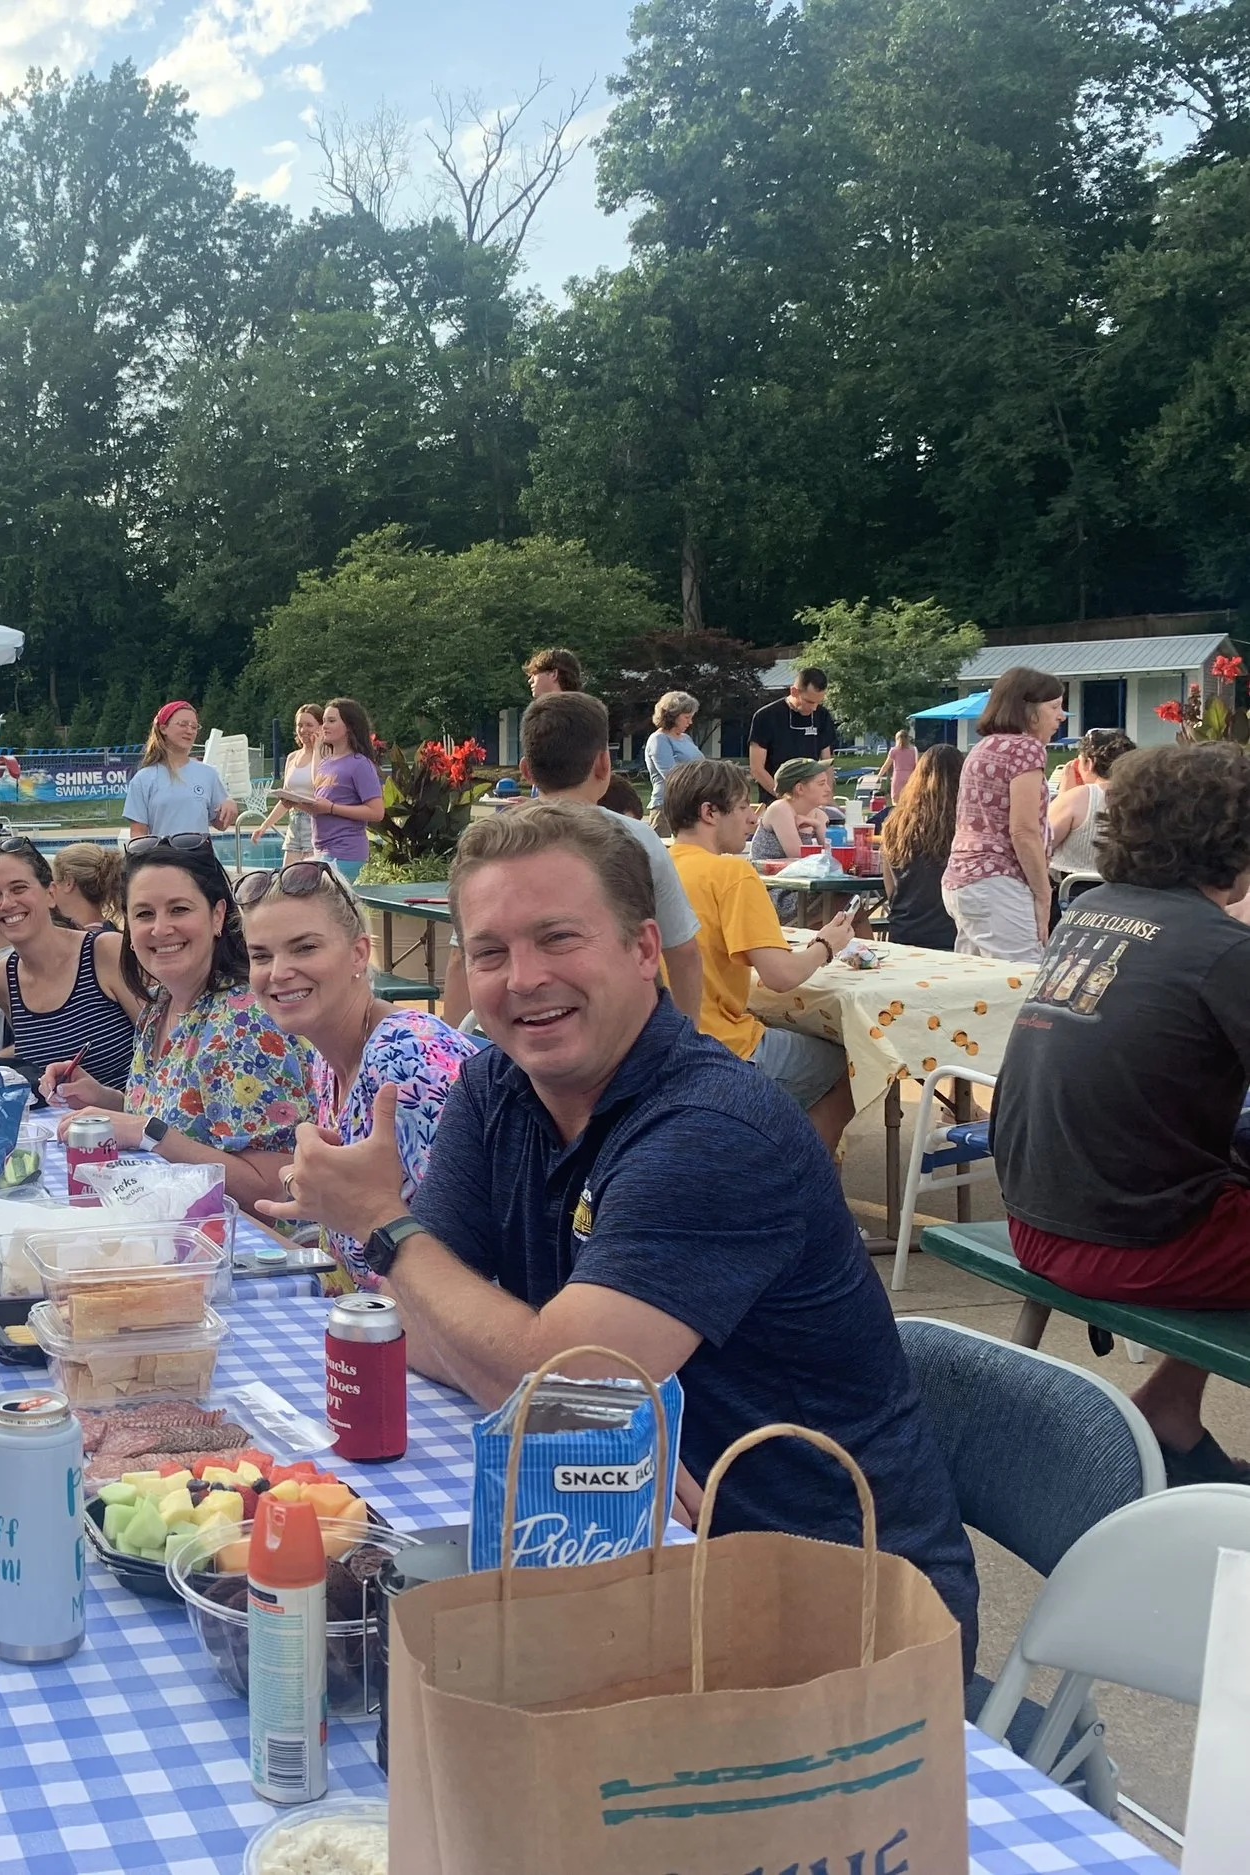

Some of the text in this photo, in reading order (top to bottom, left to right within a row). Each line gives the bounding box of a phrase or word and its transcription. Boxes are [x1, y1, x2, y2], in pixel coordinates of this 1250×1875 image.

[55, 770, 127, 785] SHINE ON
[55, 784, 128, 797] SWIM-A-THON
[1074, 912, 1109, 929] JUICE
[1104, 916, 1161, 941] CLEANSE
[330, 1375, 361, 1395] Does
[561, 1470, 630, 1486] SNACK
[512, 1508, 648, 1568] Pretzel
